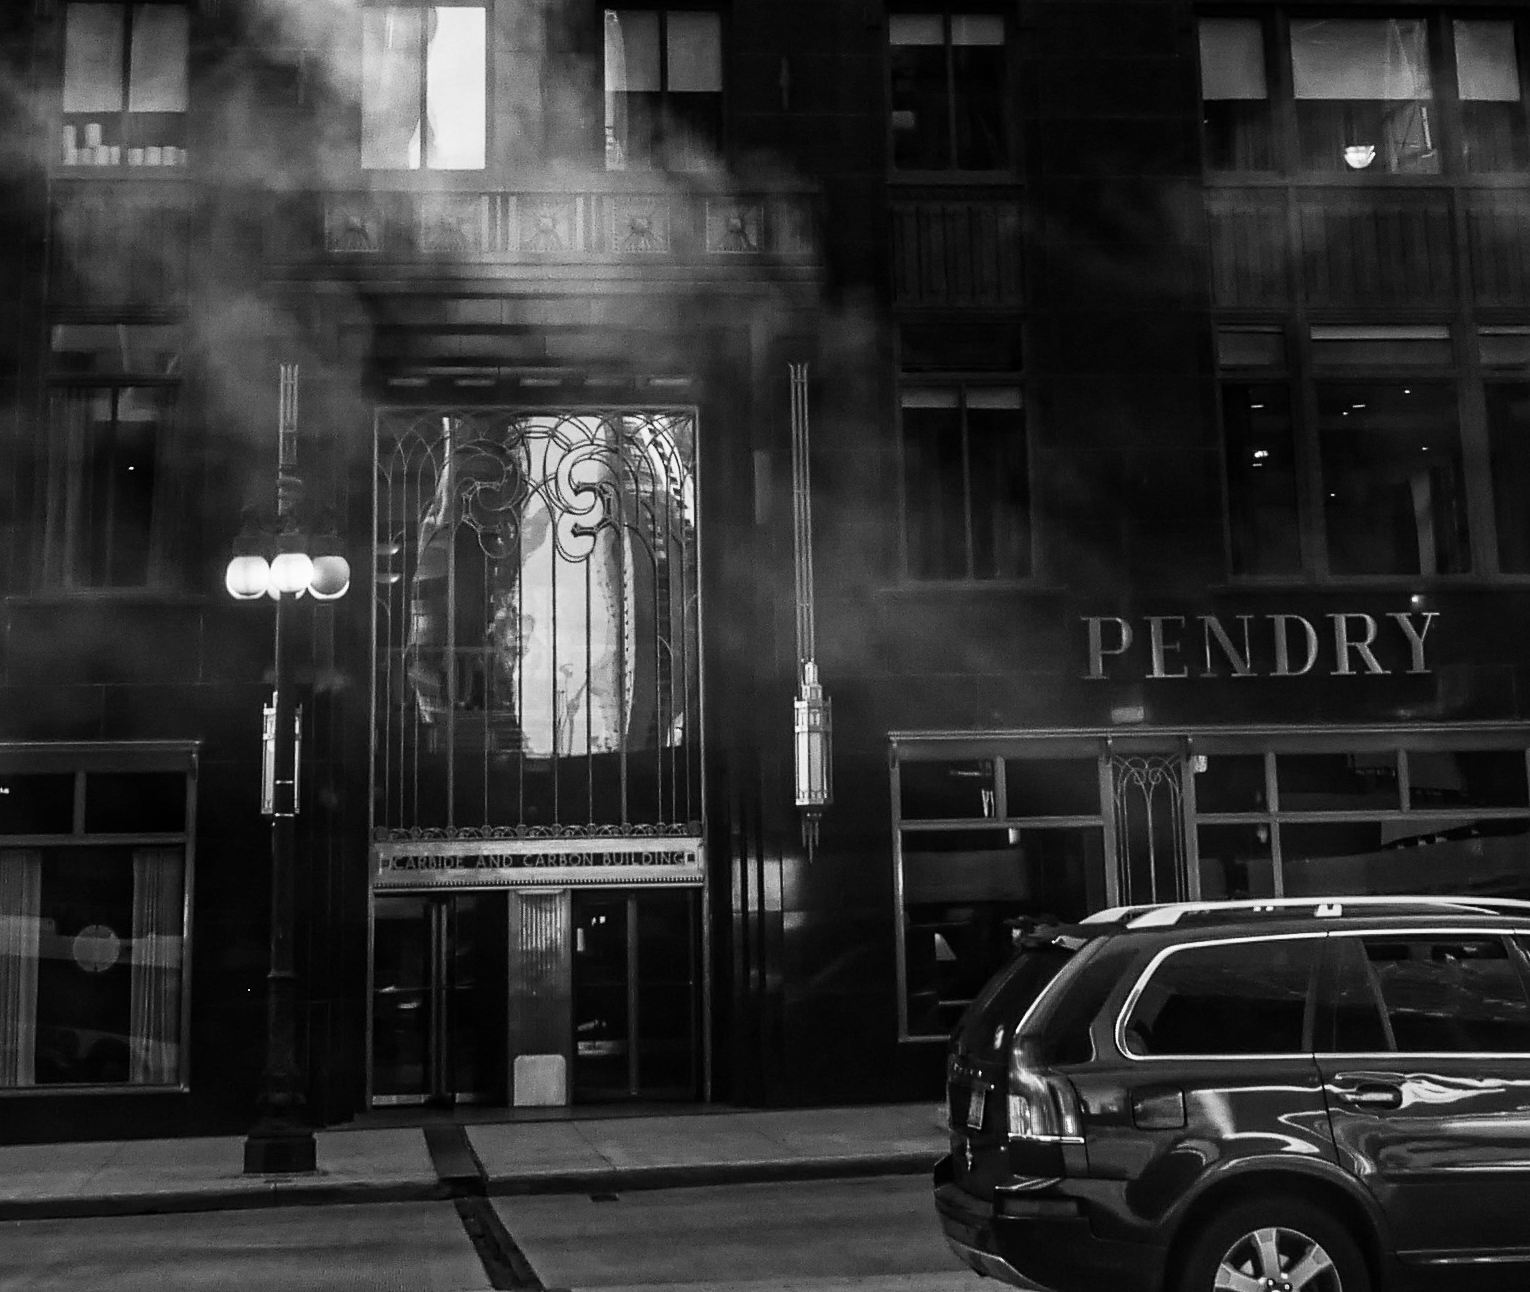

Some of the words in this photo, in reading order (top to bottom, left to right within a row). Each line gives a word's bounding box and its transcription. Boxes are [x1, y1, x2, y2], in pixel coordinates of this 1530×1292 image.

[1080, 612, 1441, 680] PENDRY
[475, 854, 513, 868] AND
[523, 853, 594, 868] CARBON
[603, 851, 685, 866] BUILDING
